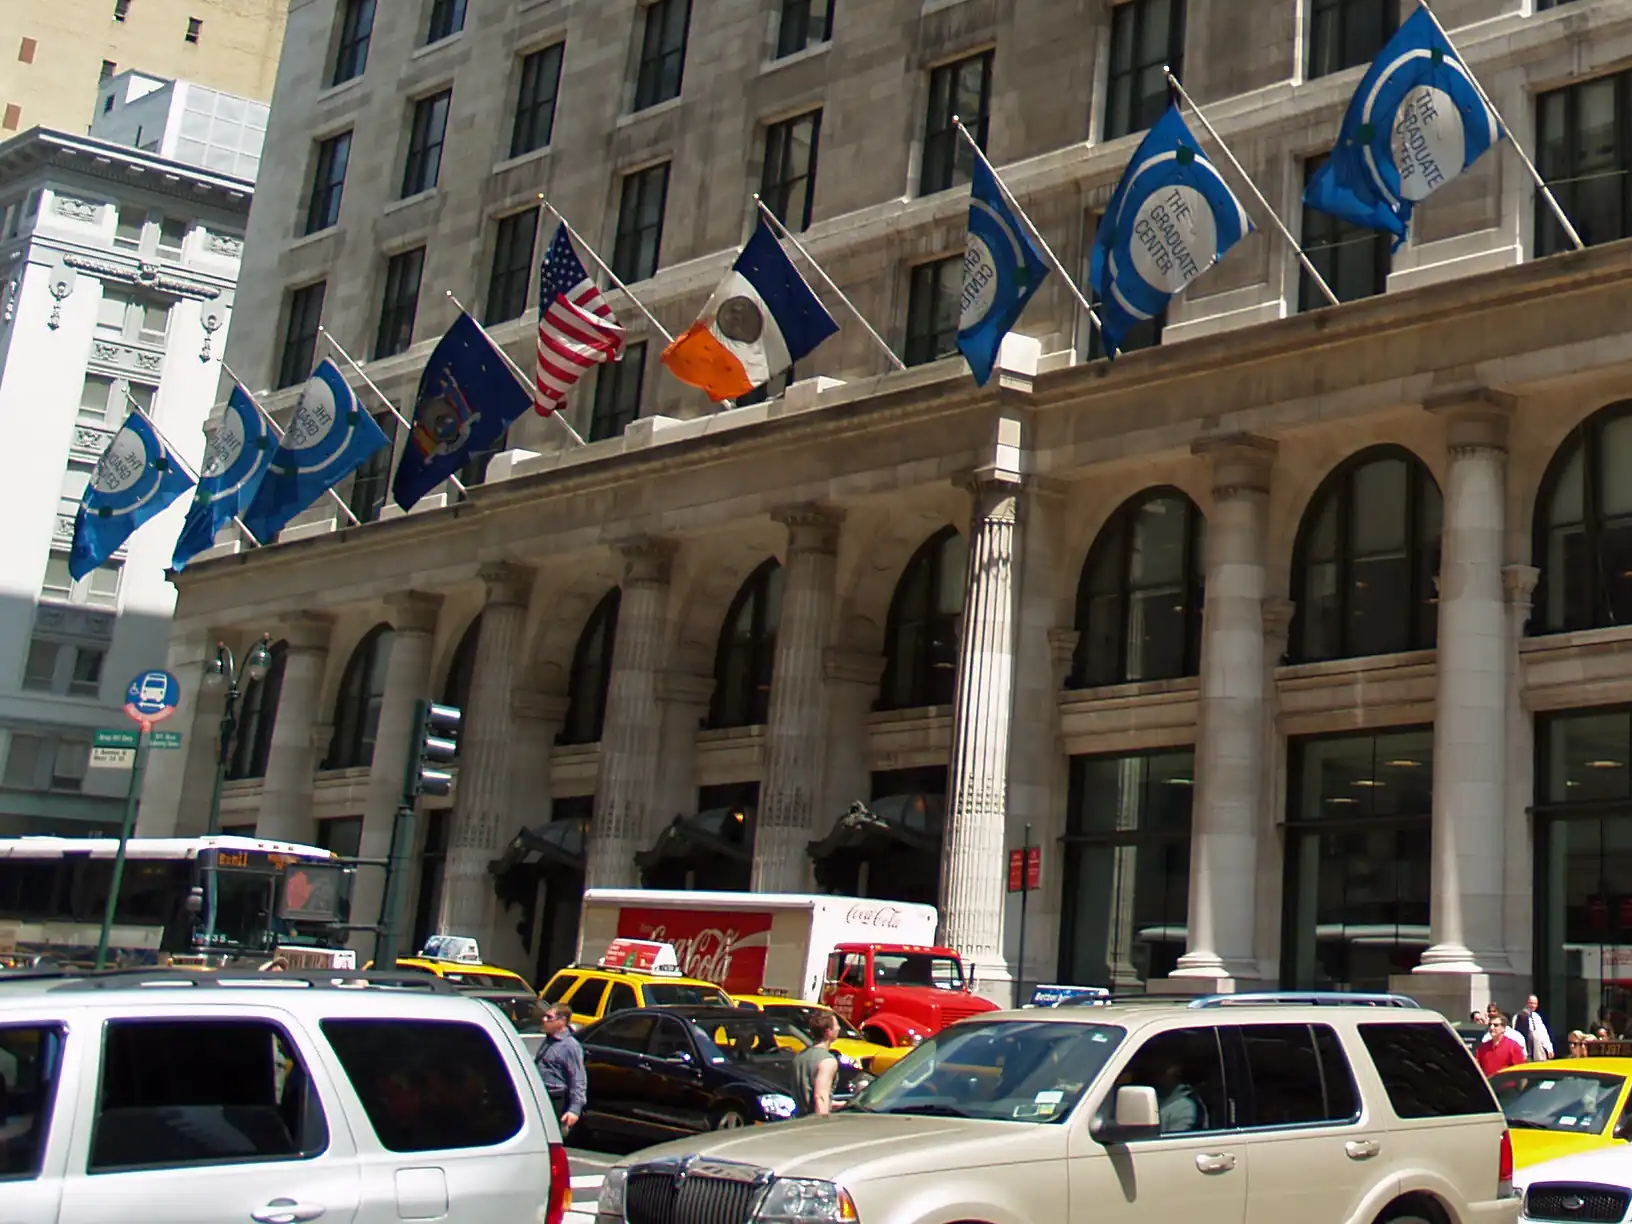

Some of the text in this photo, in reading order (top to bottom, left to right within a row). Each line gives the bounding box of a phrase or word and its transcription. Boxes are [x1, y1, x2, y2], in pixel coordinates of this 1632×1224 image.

[1416, 89, 1439, 126] THE
[1404, 104, 1445, 189] GRADUATE
[1165, 188, 1191, 223] THE
[1134, 219, 1173, 276] CENTER
[1150, 204, 1199, 281] GRADUATE
